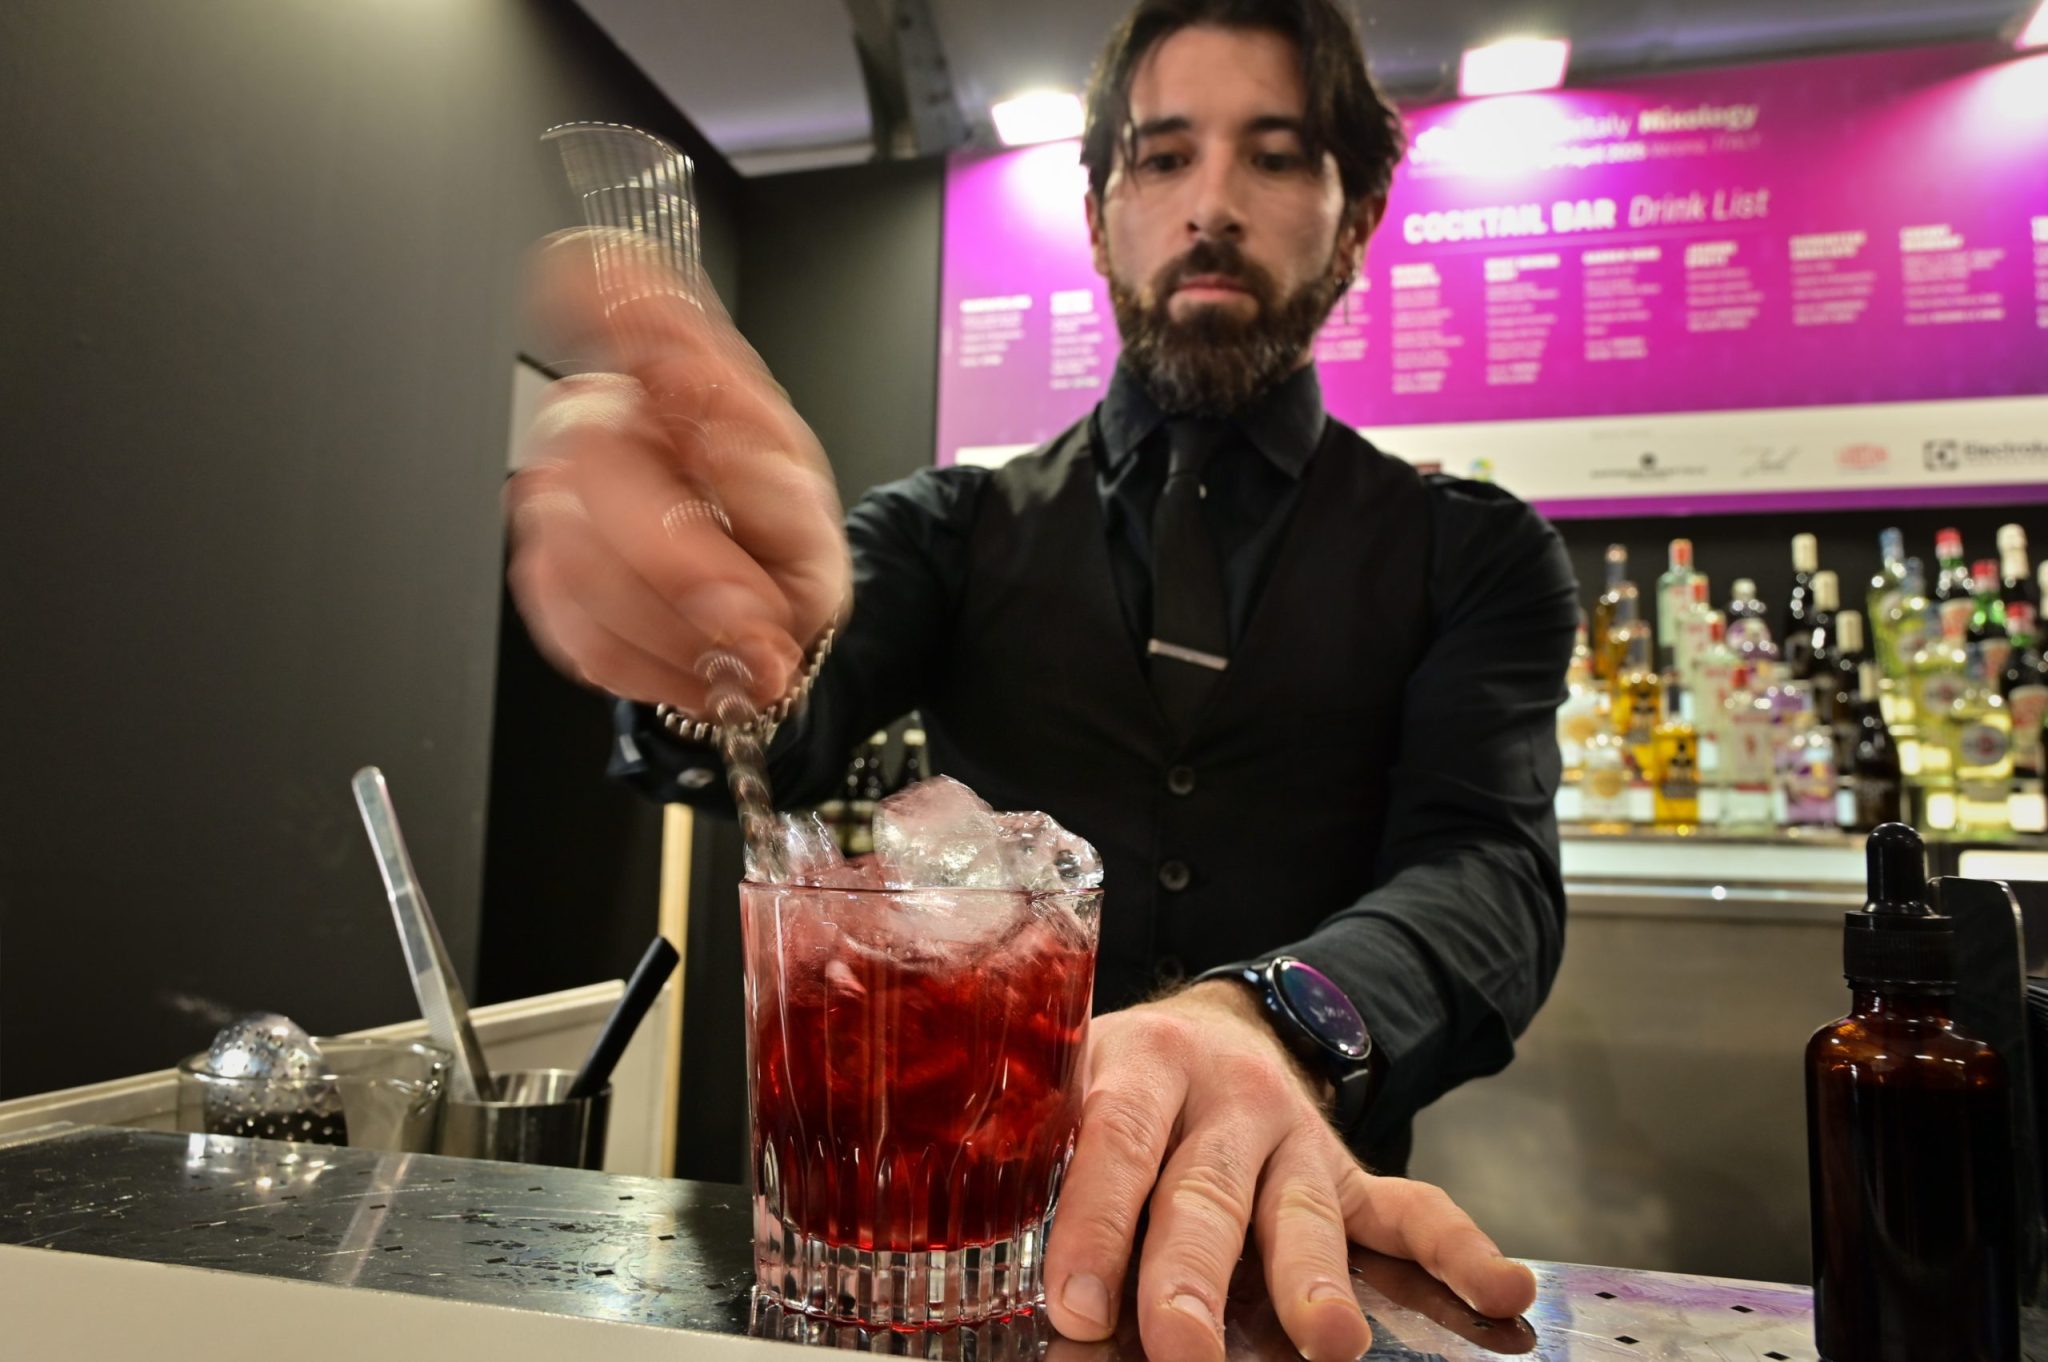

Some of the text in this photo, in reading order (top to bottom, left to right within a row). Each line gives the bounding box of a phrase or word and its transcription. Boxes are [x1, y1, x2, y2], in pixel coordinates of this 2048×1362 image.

[1637, 104, 1760, 134] Mixology
[1403, 187, 1769, 245] COCKTAIL BAR Drink List
